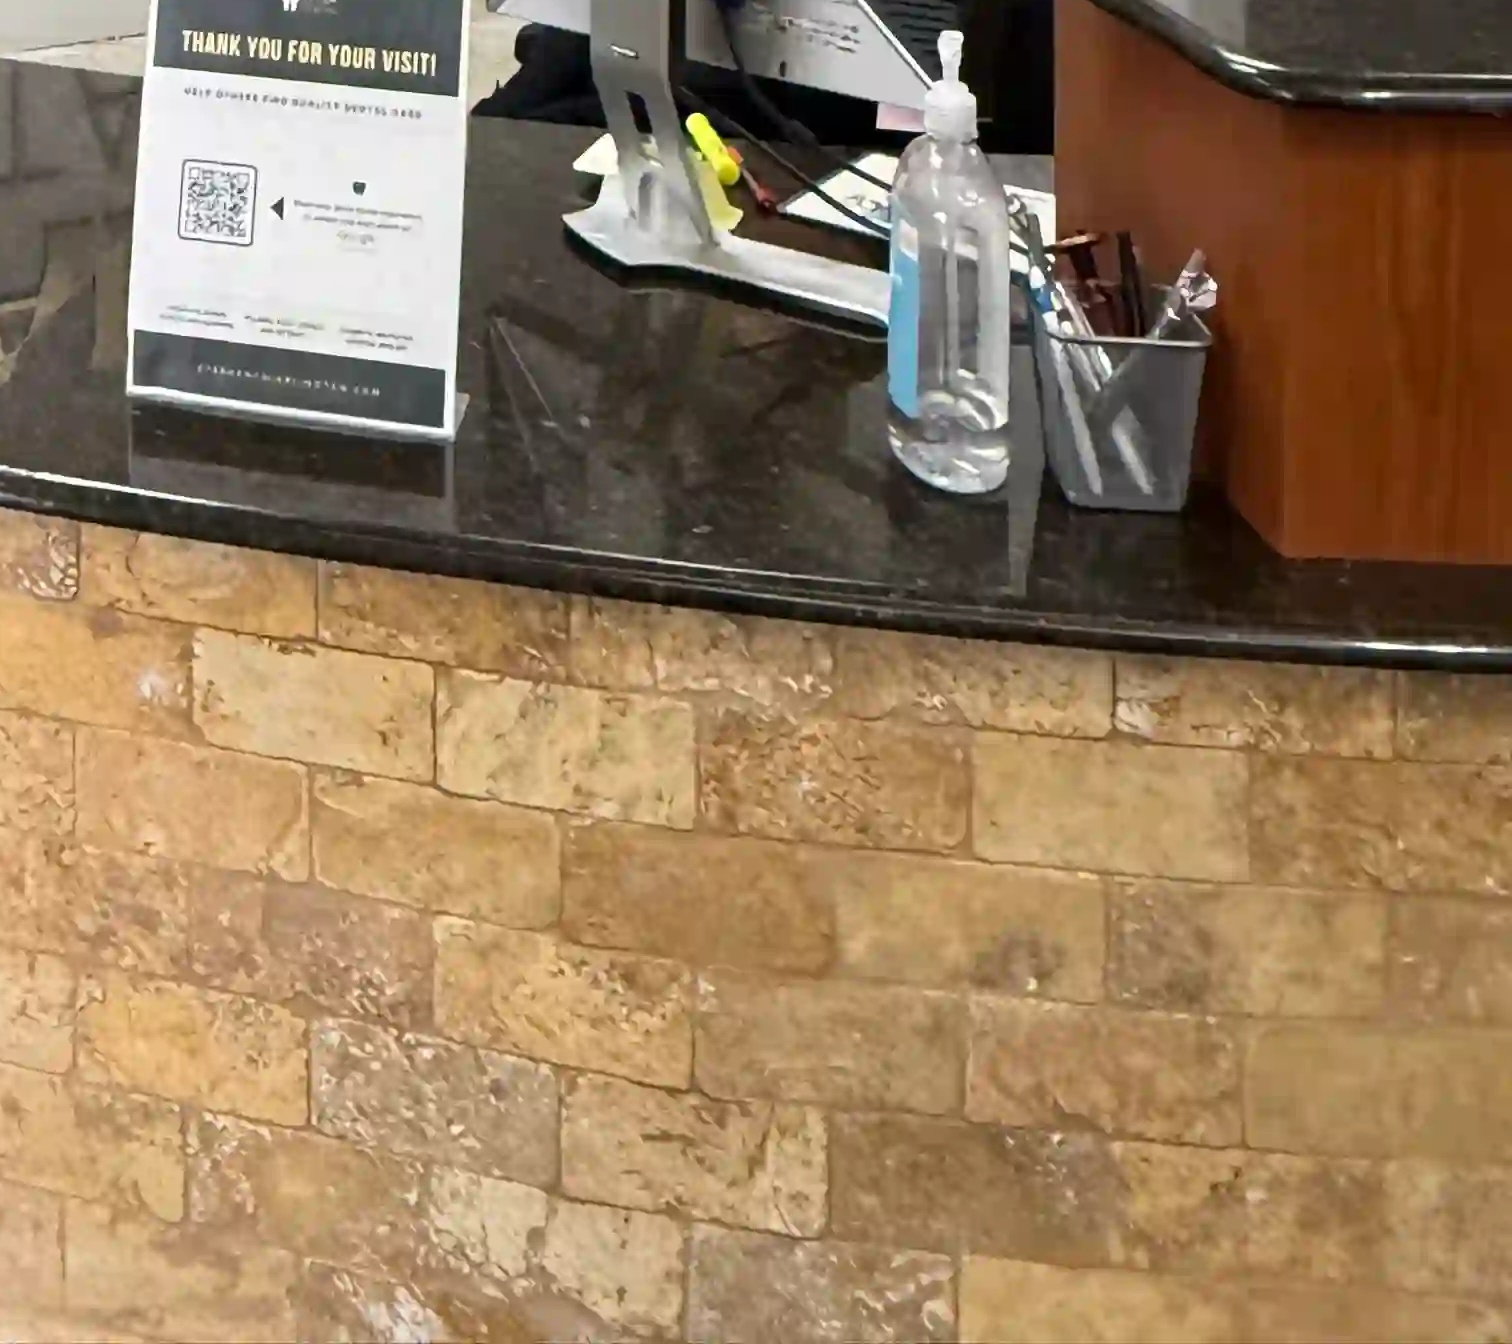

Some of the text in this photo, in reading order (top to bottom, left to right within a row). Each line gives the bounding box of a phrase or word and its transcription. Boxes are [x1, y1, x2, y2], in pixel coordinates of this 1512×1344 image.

[182, 29, 438, 78] THANK YOU FOR YOUR VISIT!
